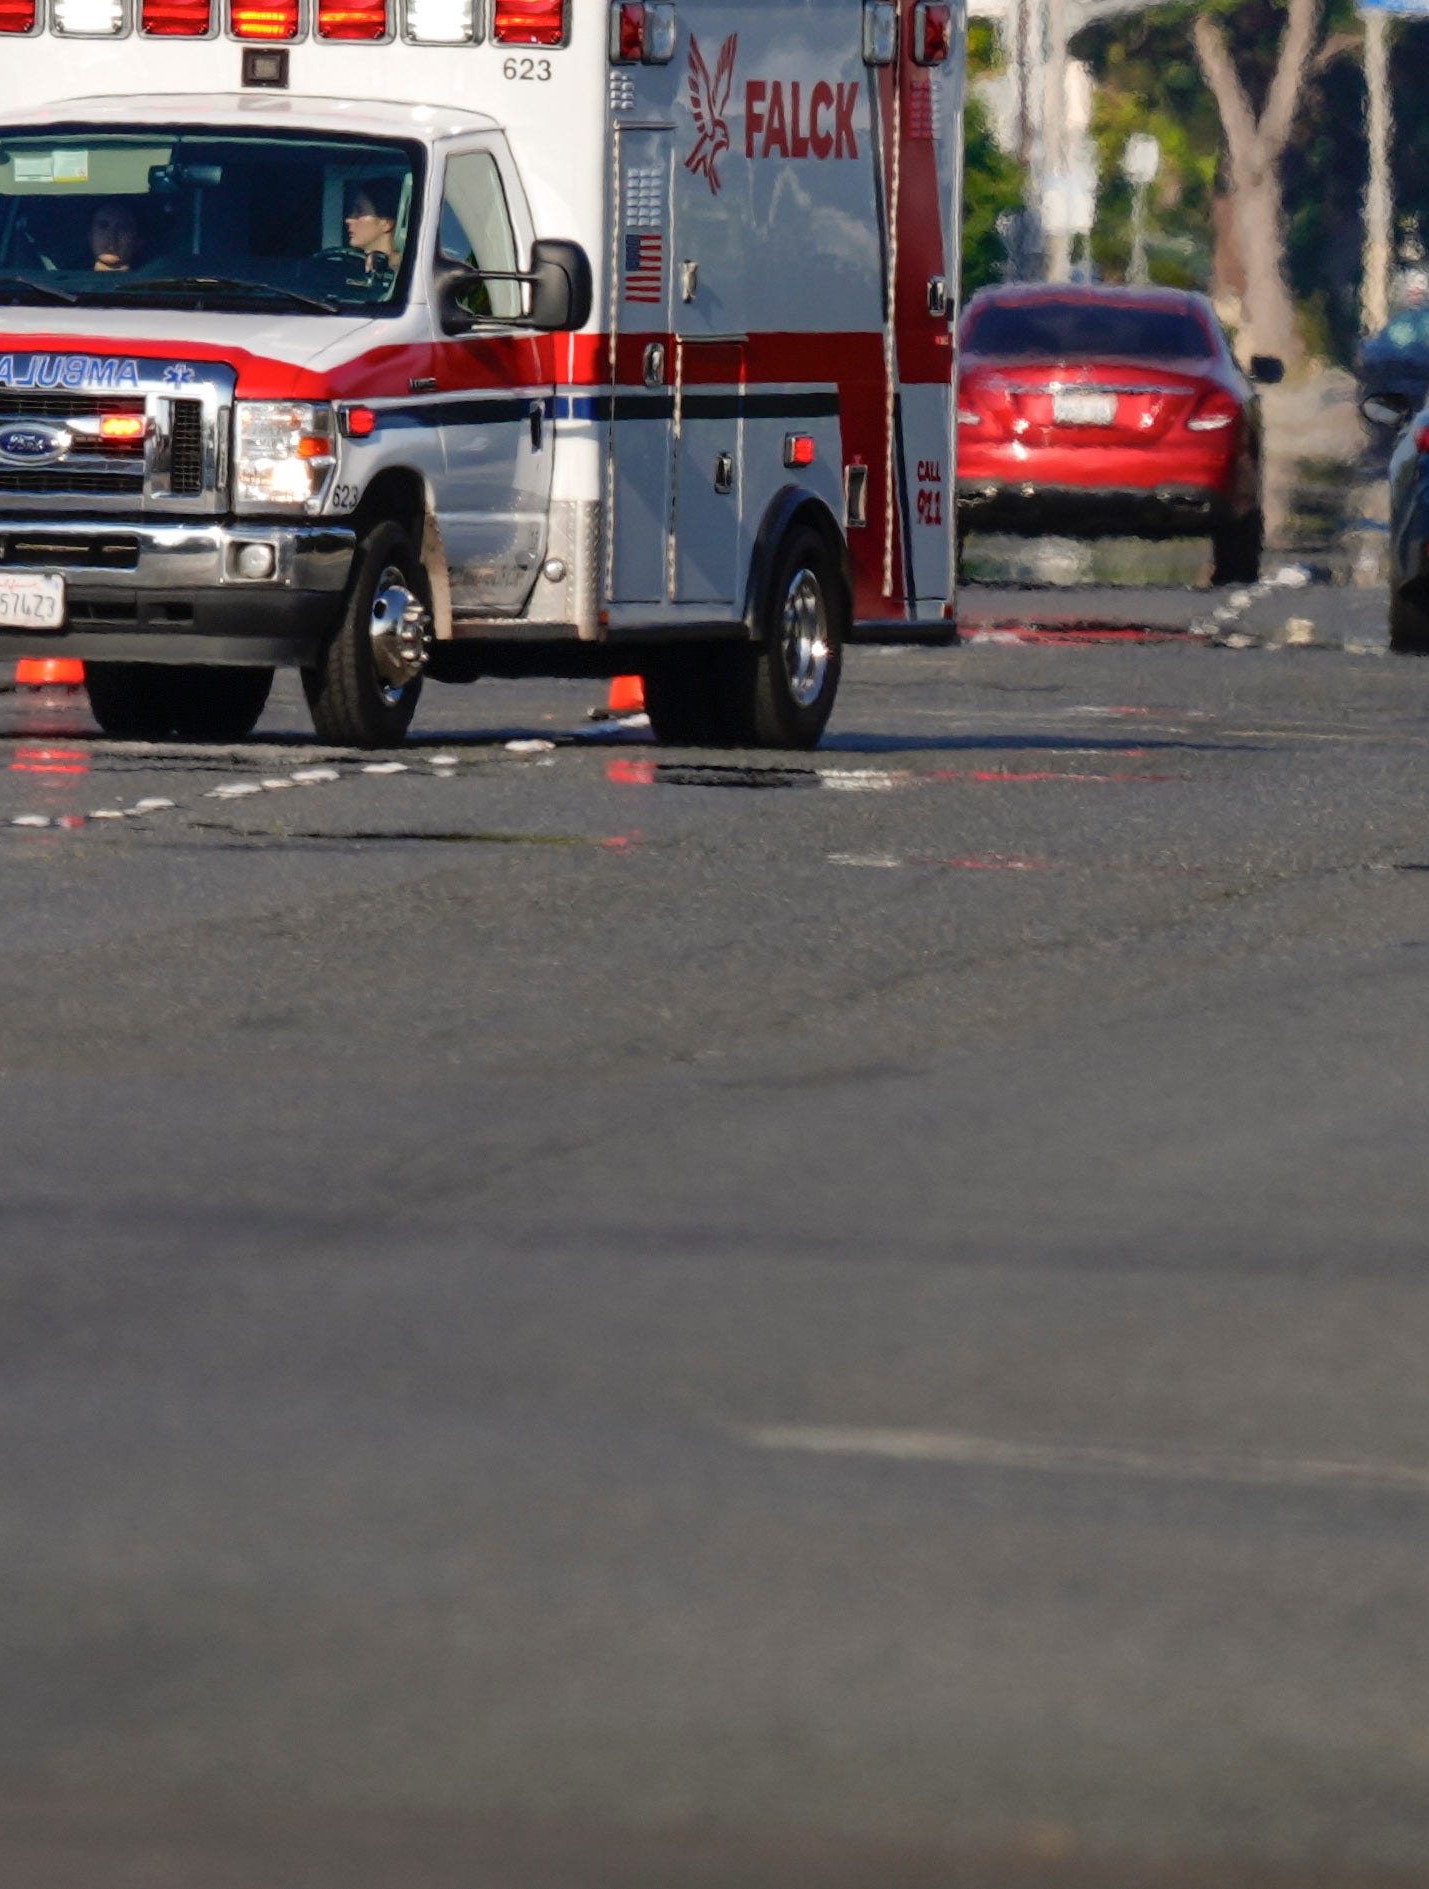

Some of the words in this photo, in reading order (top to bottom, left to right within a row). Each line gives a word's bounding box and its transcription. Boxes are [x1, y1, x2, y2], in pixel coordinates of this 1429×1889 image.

[502, 58, 553, 82] 623
[745, 80, 860, 160] FALCK
[917, 460, 941, 482] CALL
[332, 484, 359, 508] 623
[917, 488, 942, 525] 911
